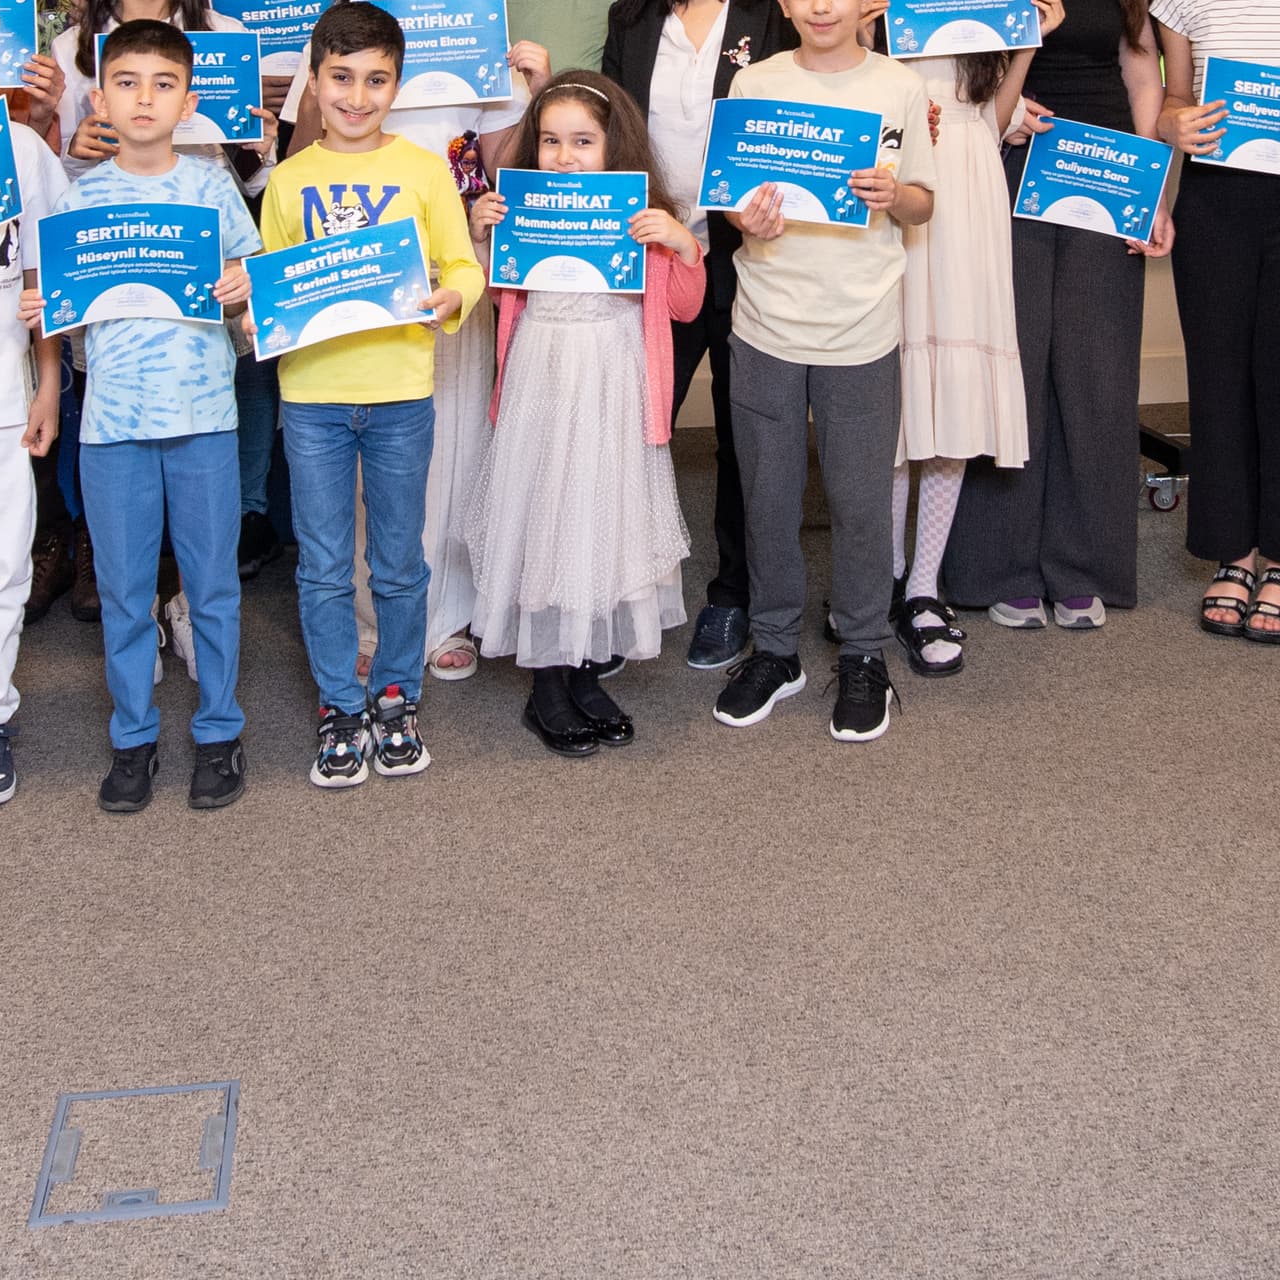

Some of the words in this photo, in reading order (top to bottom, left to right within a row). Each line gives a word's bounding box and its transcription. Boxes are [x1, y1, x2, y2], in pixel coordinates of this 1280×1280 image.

[242, 2, 321, 21] SERTİFİKAT
[397, 12, 474, 30] ERTİFİKAT
[440, 36, 477, 47] Elnarə
[190, 74, 235, 86] Nərmin
[1233, 101, 1280, 117] Quliyeva
[745, 119, 844, 143] SERTİFİKAT
[736, 141, 810, 160] Dəstibəyov
[811, 150, 846, 164] Onur
[1057, 138, 1139, 167] SERTİFİKAT
[1056, 159, 1102, 177] Quliyeva
[1103, 169, 1129, 184] Sara
[524, 192, 612, 209] SERTİFİKAT
[300, 184, 400, 243] NY
[515, 216, 587, 230] Məmmədova
[590, 219, 621, 230] Aida
[76, 221, 183, 244] SERTİFİKAT
[77, 248, 136, 265] Hüseynli
[139, 247, 184, 260] Kənan
[284, 242, 383, 279] SERTİFİKAT
[293, 272, 339, 294] Kərimli
[341, 264, 381, 281] Sadiq
